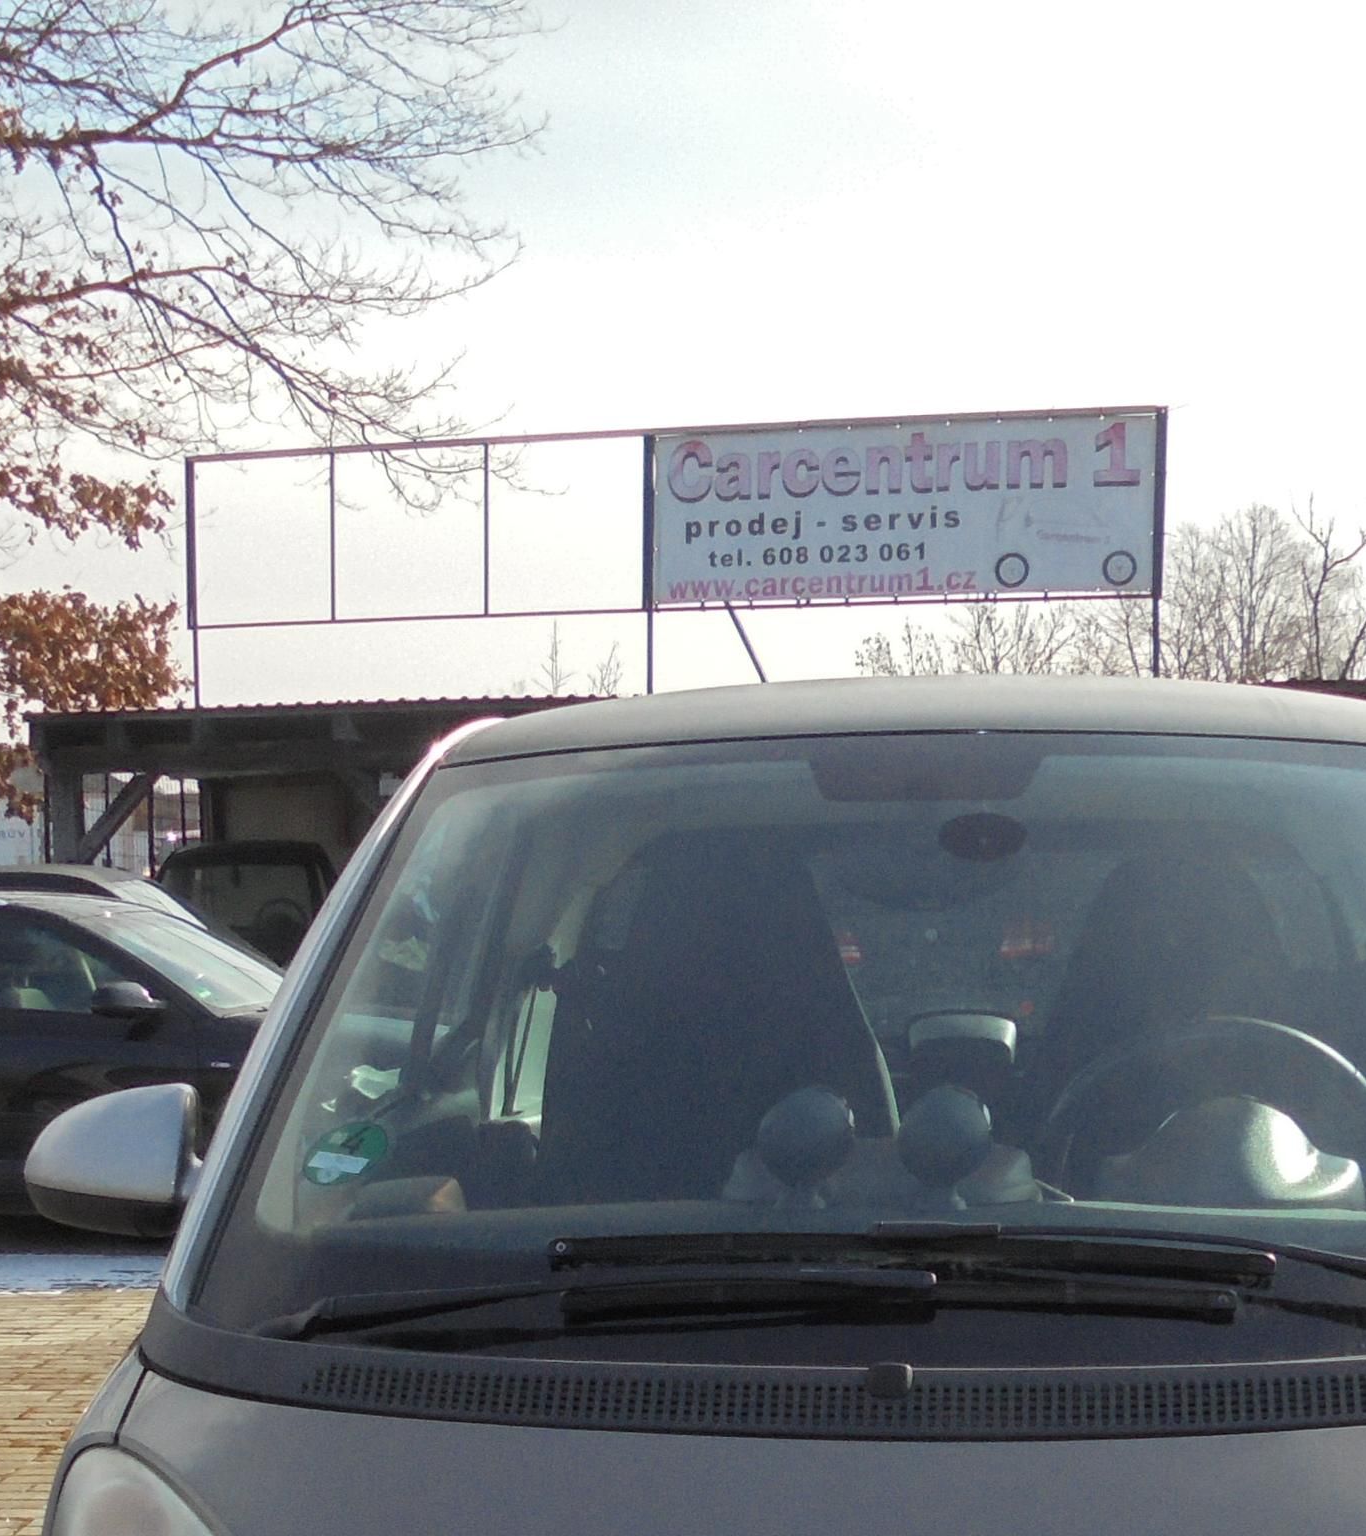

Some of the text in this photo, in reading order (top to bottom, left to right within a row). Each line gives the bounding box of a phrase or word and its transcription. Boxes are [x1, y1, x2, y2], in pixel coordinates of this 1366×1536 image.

[667, 422, 1141, 503] Carcentrum 1
[685, 511, 801, 544] prodej
[841, 505, 961, 532] servis
[708, 541, 926, 568] tel. 608 023 061
[668, 566, 977, 600] www.carcentrum1.cz
